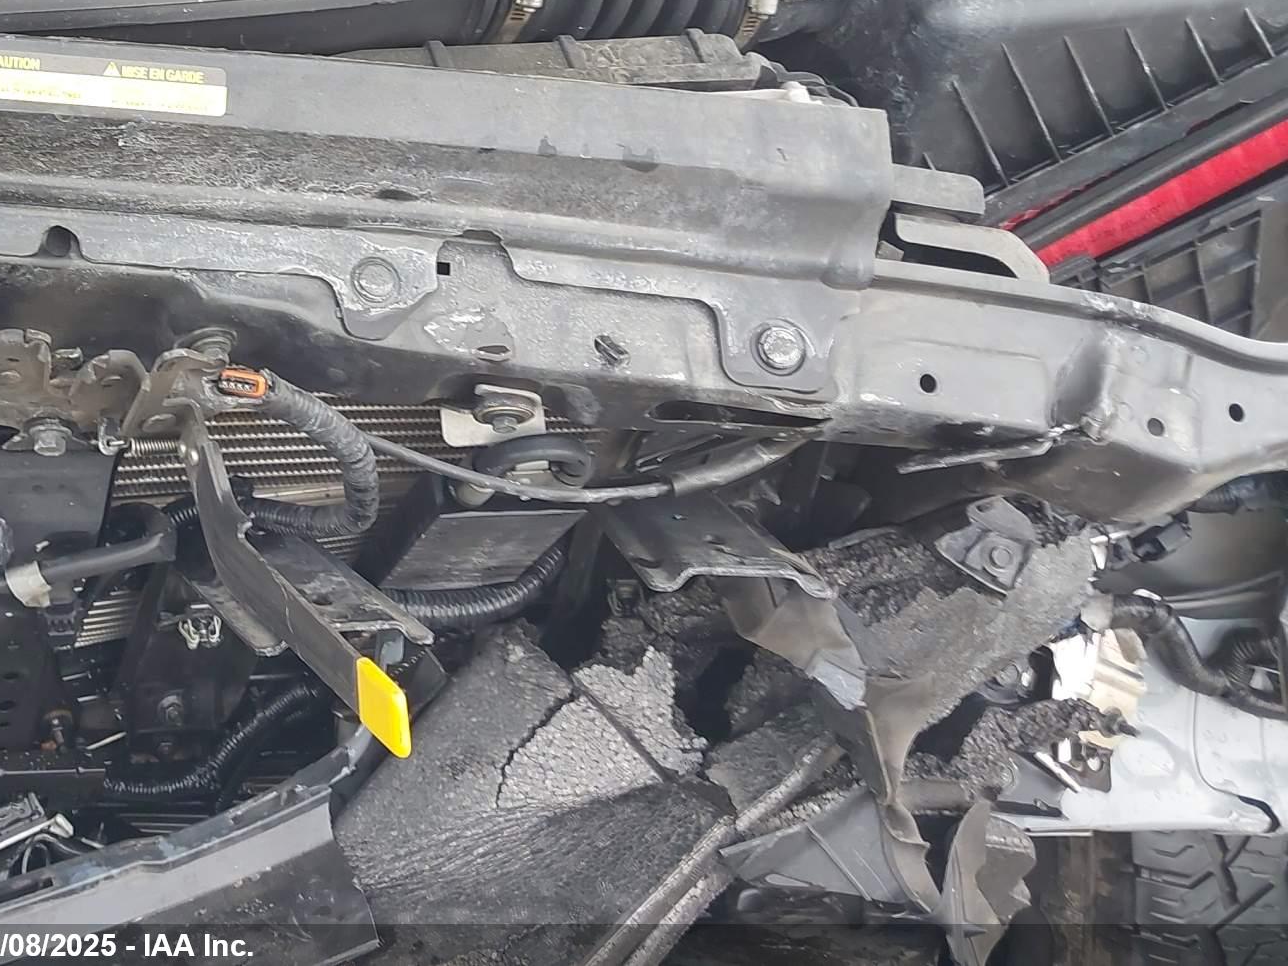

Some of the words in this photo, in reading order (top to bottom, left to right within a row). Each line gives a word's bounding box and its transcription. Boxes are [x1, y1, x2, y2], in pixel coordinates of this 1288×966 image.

[121, 65, 148, 79] MISE
[149, 67, 165, 81] EN
[166, 68, 204, 84] GARDE
